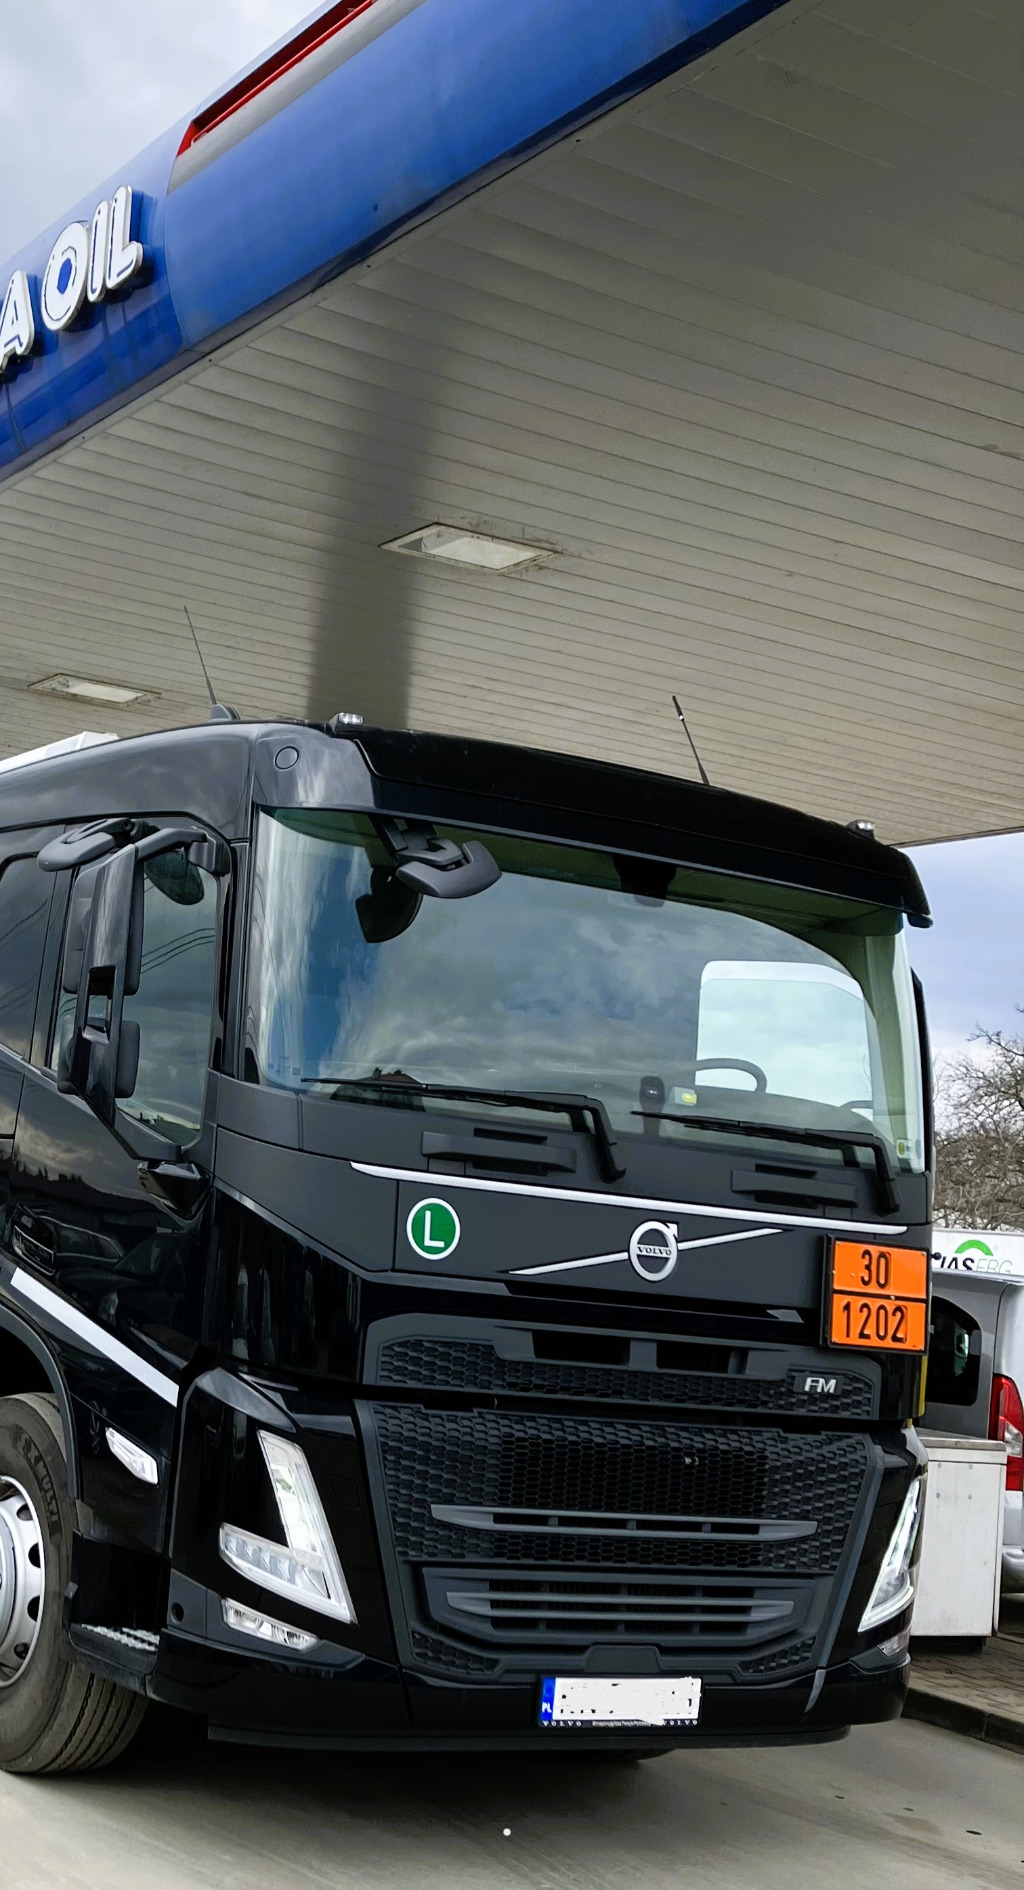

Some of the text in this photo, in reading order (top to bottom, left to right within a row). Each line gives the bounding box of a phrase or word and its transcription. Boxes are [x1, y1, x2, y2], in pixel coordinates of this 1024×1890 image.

[41, 184, 144, 331] OIL
[424, 1210, 445, 1248] L
[637, 1246, 672, 1256] VOLVO
[860, 1249, 889, 1289] 30
[842, 1300, 907, 1344] 1202
[804, 1377, 837, 1393] FM
[542, 1701, 553, 1713] PL
